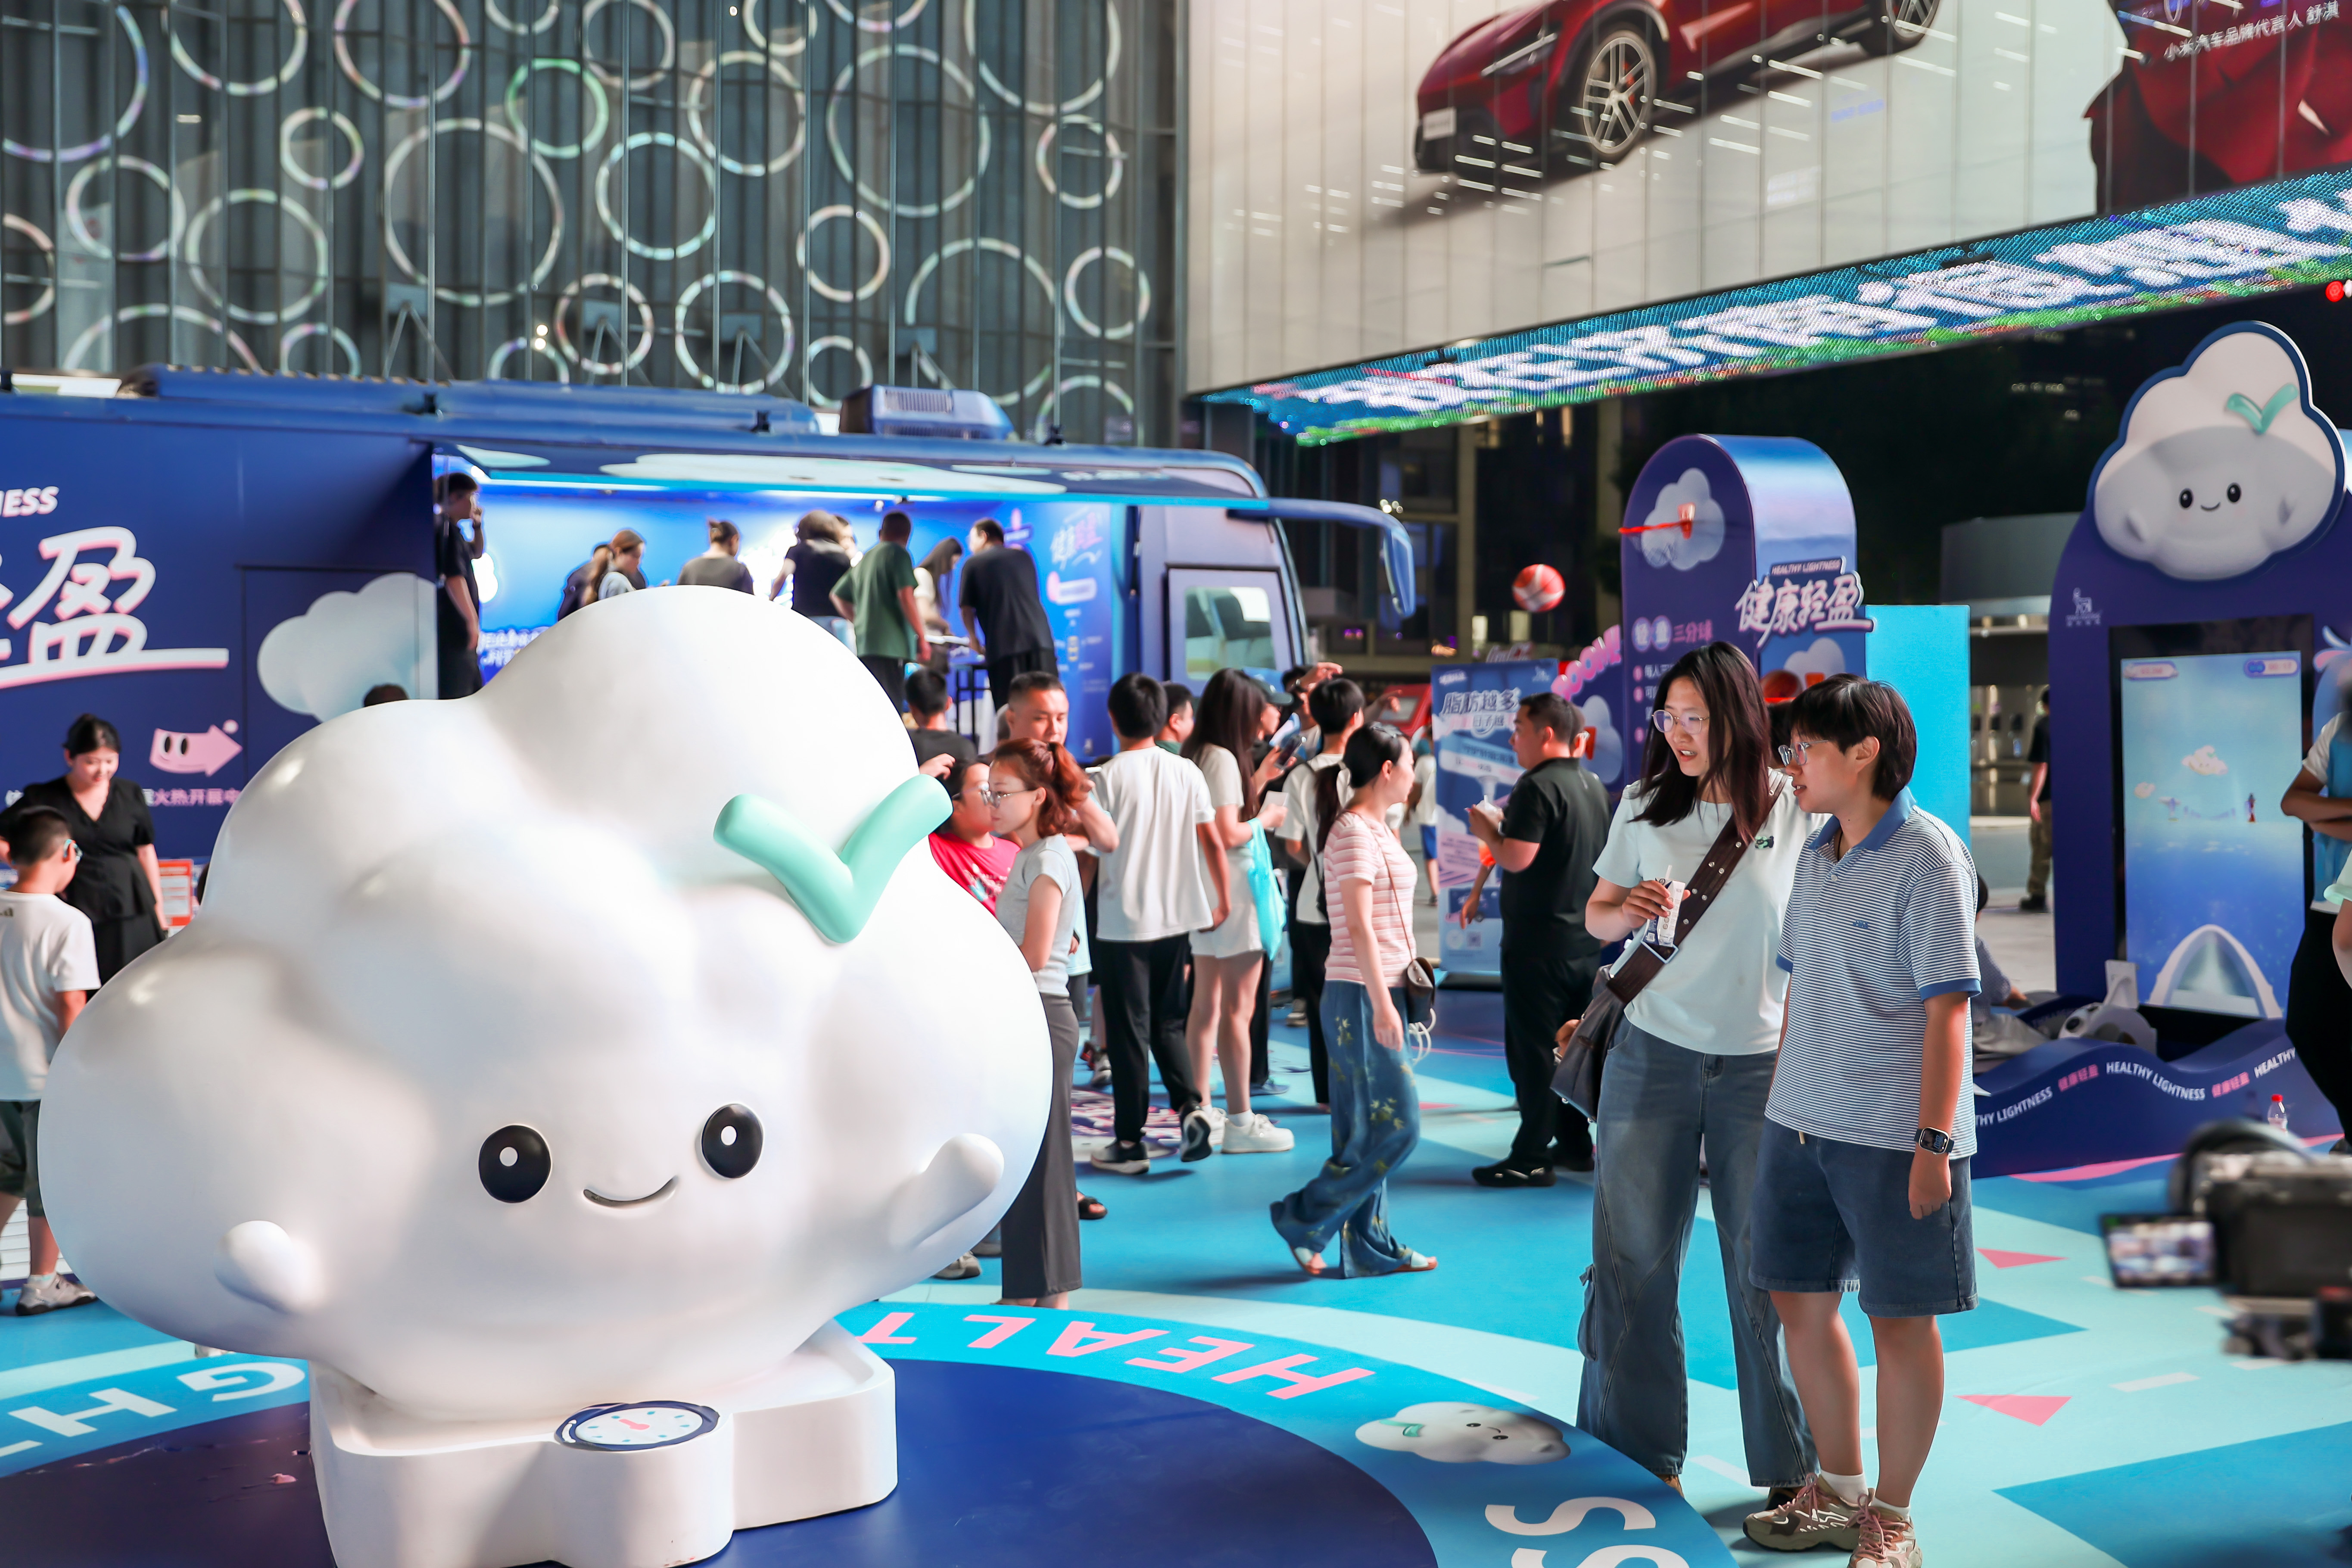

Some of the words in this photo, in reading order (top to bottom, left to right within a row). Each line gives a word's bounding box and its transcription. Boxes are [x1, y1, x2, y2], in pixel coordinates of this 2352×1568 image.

[2164, 10, 2304, 61] 小米汽车品牌代言人
[0, 486, 59, 517] ESS
[1771, 562, 1801, 576] HEALTHY
[1802, 560, 1841, 572] LIGHTNESS
[0, 526, 230, 688] 盈
[1734, 574, 1873, 648] 健康轻盈
[2106, 1061, 2153, 1081] HEALTHY
[2153, 1073, 2206, 1101] LIGHTNESS
[2254, 1047, 2296, 1079] HEALTHY
[1997, 1086, 2053, 1123] LIGHTNESS
